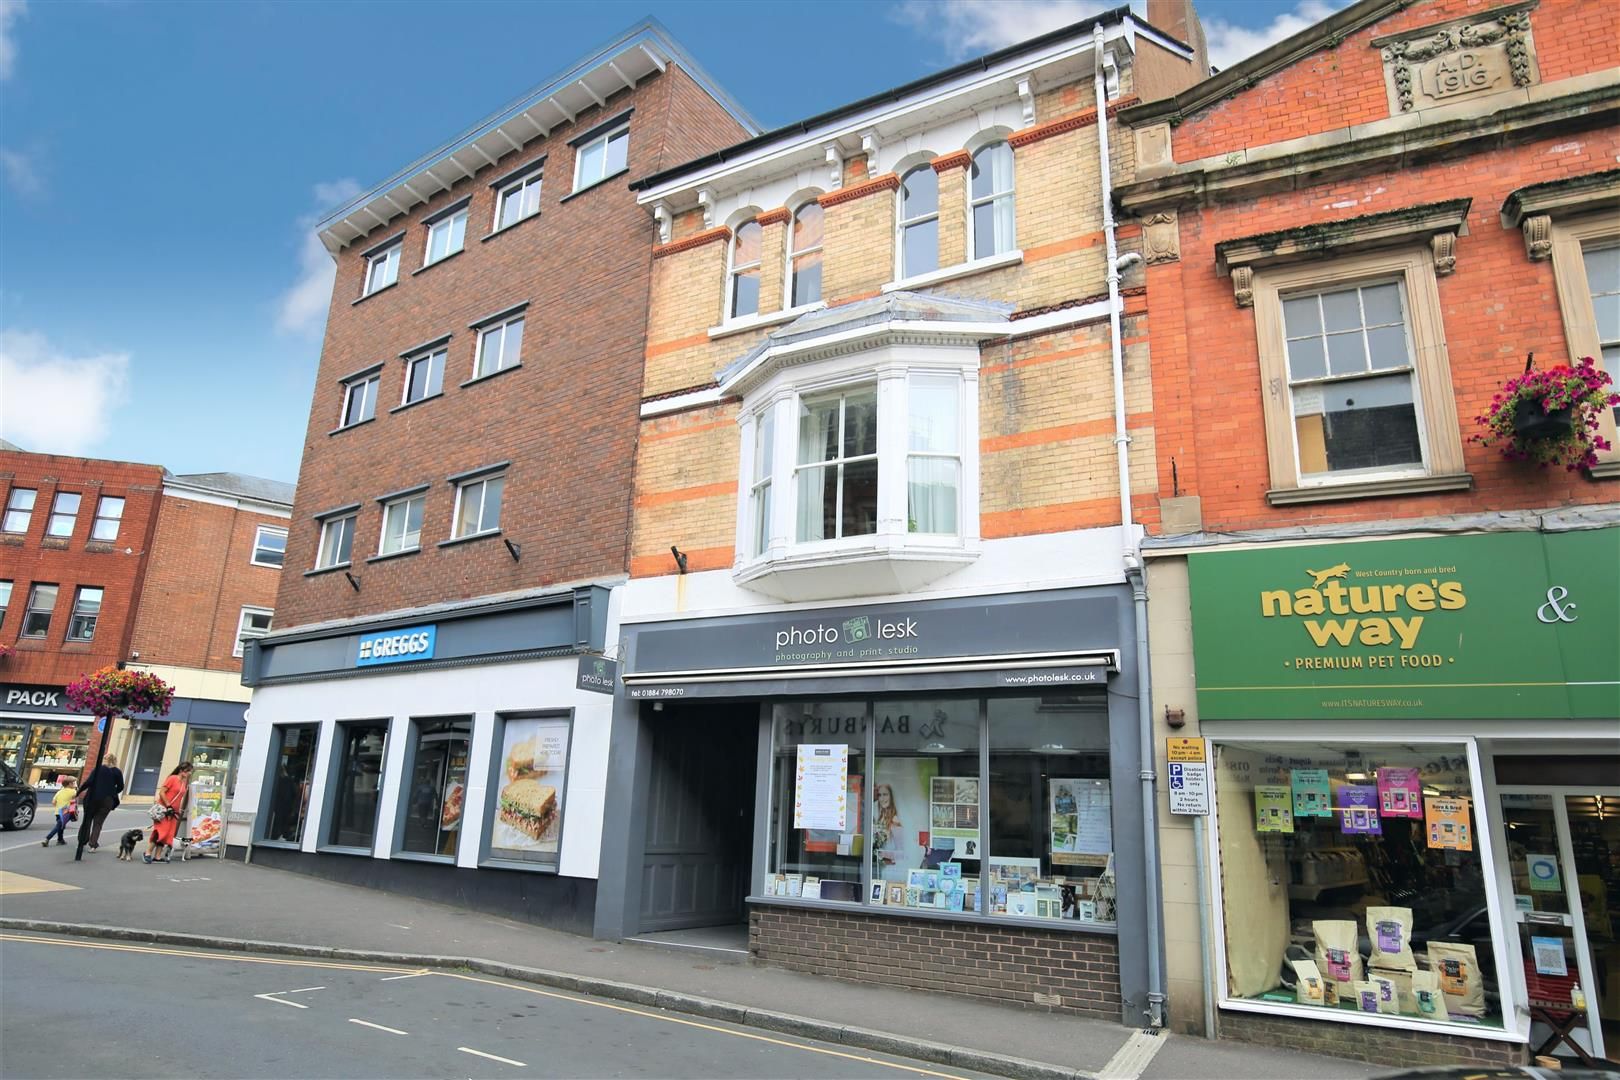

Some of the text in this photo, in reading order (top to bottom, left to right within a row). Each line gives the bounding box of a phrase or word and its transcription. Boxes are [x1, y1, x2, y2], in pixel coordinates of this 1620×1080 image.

[1436, 69, 1489, 94] 1916
[1374, 568, 1403, 576] Country
[1404, 567, 1422, 575] born
[1423, 566, 1437, 574] and
[1438, 565, 1456, 573] bred
[1261, 579, 1467, 617] nature's
[1537, 585, 1579, 624] &
[775, 617, 918, 650] photo lesk
[1303, 616, 1424, 649] way
[373, 631, 429, 657] GREGGS
[775, 646, 918, 662] photography and print studio
[1295, 654, 1443, 669] PREMIUM PET FOOD
[582, 674, 602, 684] photo
[1005, 672, 1095, 684] www.photolesk.co.uk
[6, 690, 59, 707] PACK
[660, 688, 684, 696] 798070
[1173, 765, 1181, 775] P
